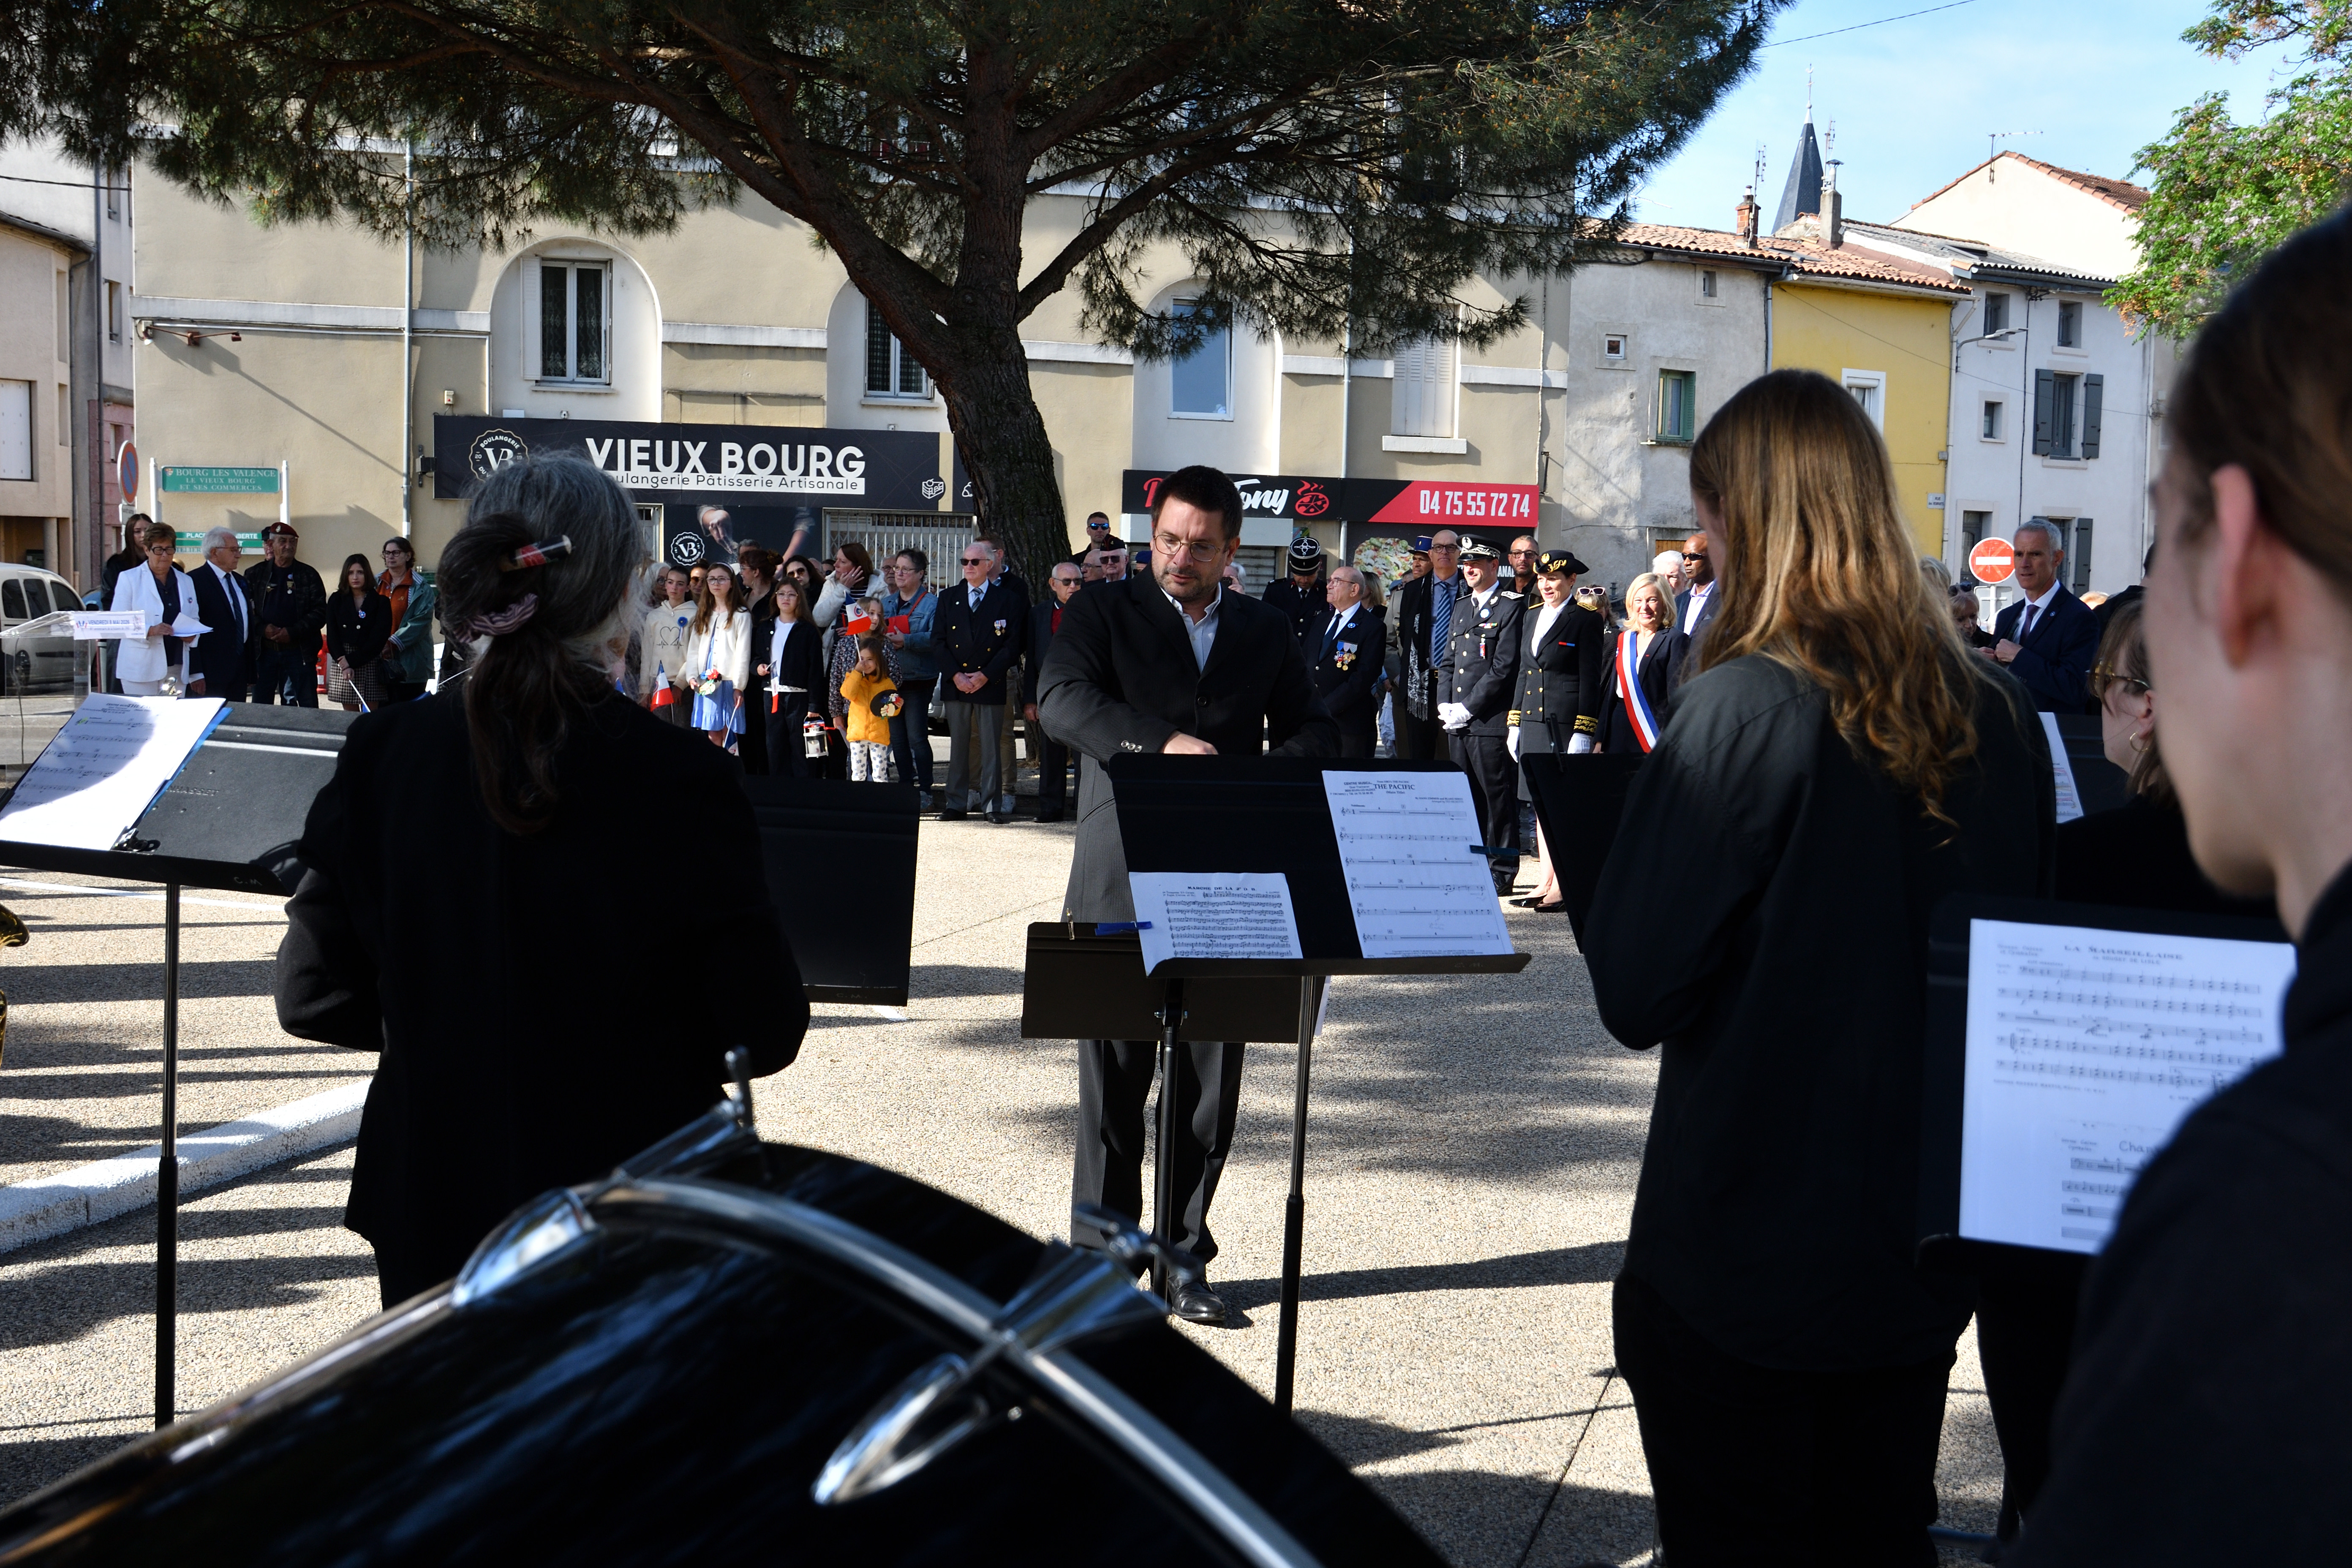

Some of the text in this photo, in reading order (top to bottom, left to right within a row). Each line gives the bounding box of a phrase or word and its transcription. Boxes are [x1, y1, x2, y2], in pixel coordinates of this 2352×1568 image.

[479, 435, 520, 449] BOULANGERIE
[585, 438, 866, 478] VIEUX BOURG
[478, 466, 487, 474] DU
[616, 473, 858, 490] ulangerie Pâtisserie Artisanale
[1420, 490, 1530, 517] 04 75 55 72 74
[169, 786, 220, 796] NHASSET
[2088, 945, 2183, 960] MARSEILLAISE
